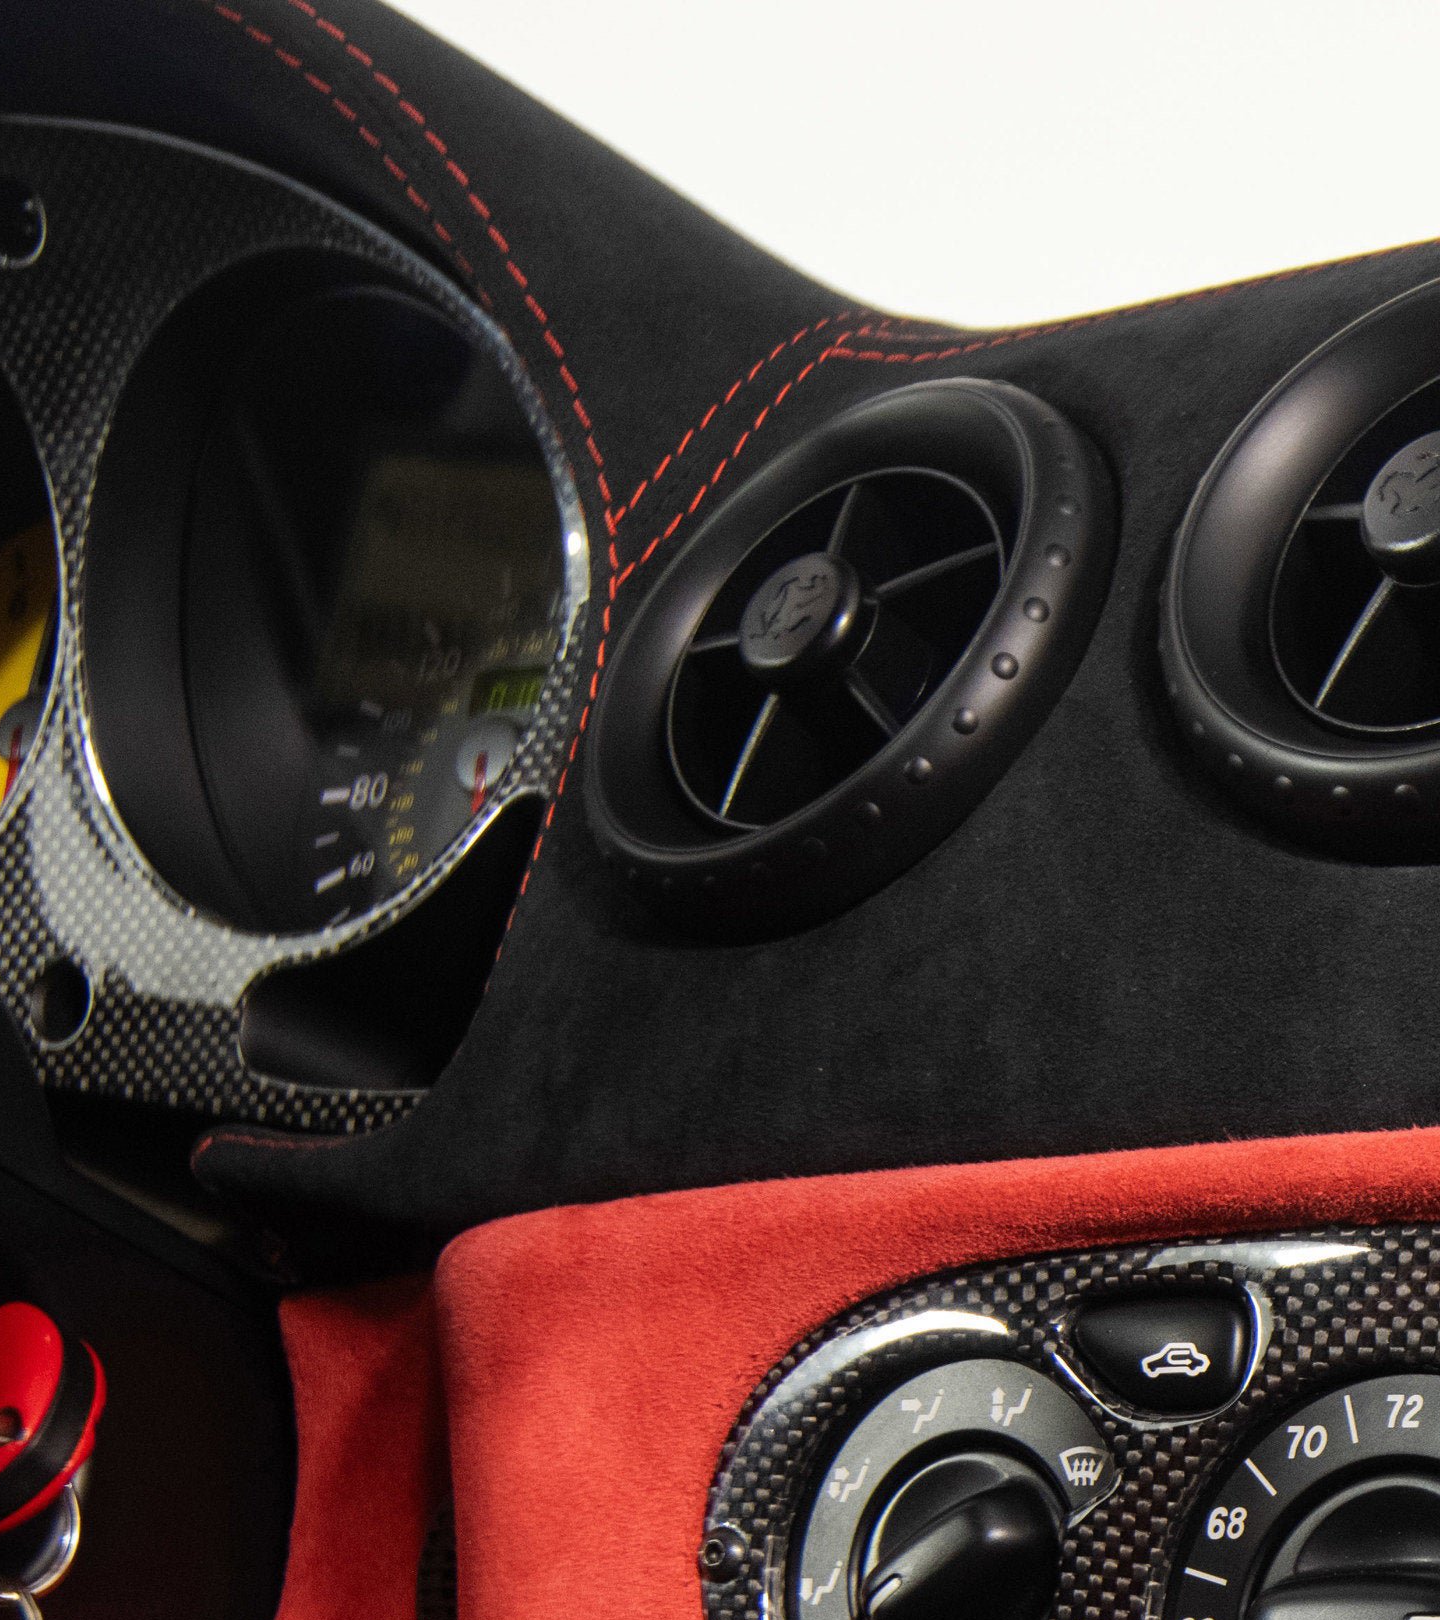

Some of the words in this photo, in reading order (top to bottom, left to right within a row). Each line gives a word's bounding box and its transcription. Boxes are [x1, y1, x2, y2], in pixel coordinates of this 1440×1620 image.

[350, 773, 389, 810] 80
[350, 851, 376, 878] 60
[1386, 1394, 1424, 1429] 72
[1287, 1424, 1328, 1460] 70
[1206, 1506, 1248, 1540] 68
